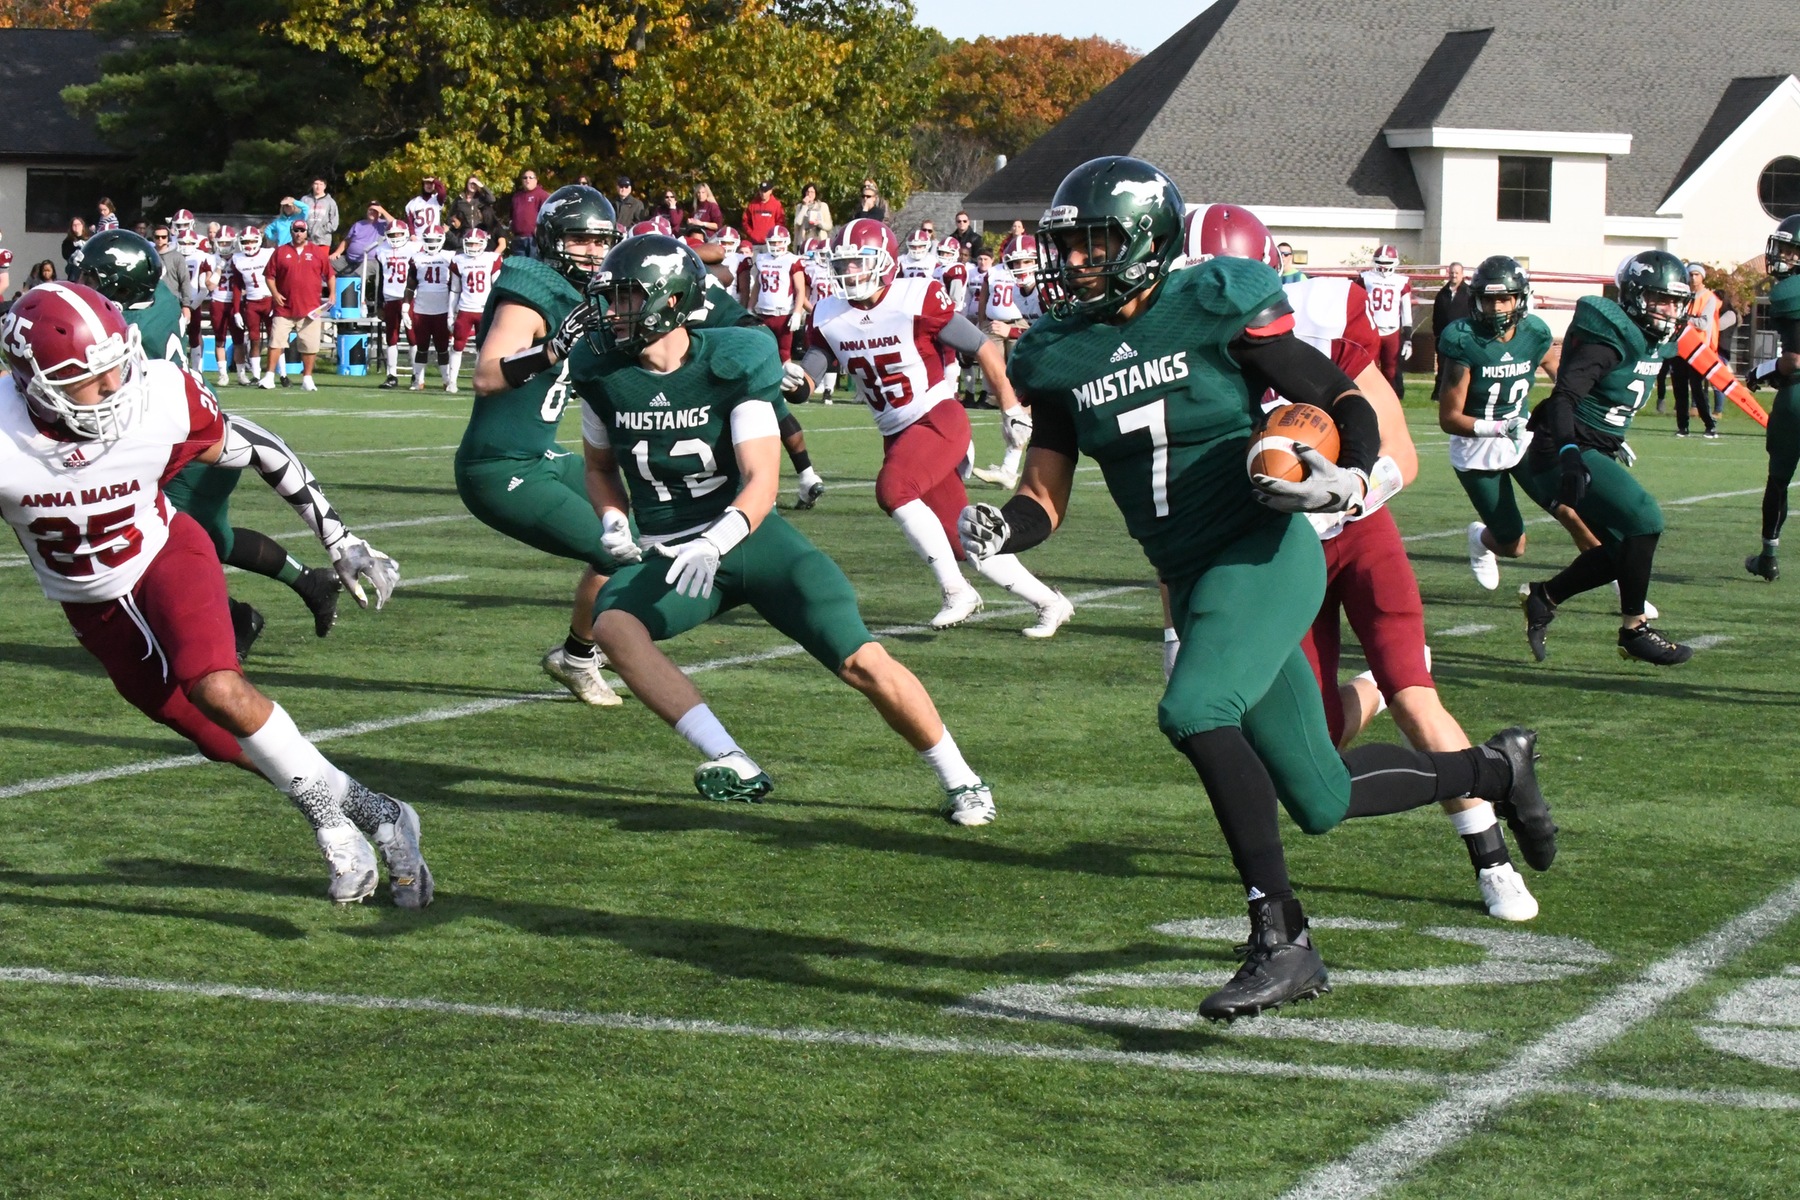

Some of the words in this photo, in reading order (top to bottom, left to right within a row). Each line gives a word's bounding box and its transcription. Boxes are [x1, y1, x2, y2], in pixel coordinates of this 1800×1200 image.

[415, 207, 435, 227] 50
[251, 272, 260, 289] 1
[387, 261, 406, 284] 79
[424, 266, 441, 284] 41
[467, 270, 486, 293] 48
[761, 268, 780, 294] 63
[1372, 287, 1394, 312] 93
[2, 312, 34, 358] 25
[840, 339, 867, 352] ANNA
[868, 334, 902, 349] MARIA
[1109, 349, 1139, 364] adidas
[1482, 360, 1531, 378] MUSTANGS
[847, 351, 914, 412] 35
[1071, 350, 1189, 412] MUSTANGS
[615, 405, 712, 430] MUSTANGS
[631, 438, 728, 502] 12
[1116, 398, 1170, 518] 7
[20, 491, 77, 508] ANNA
[81, 479, 141, 506] MARIA
[28, 503, 145, 577] 25
